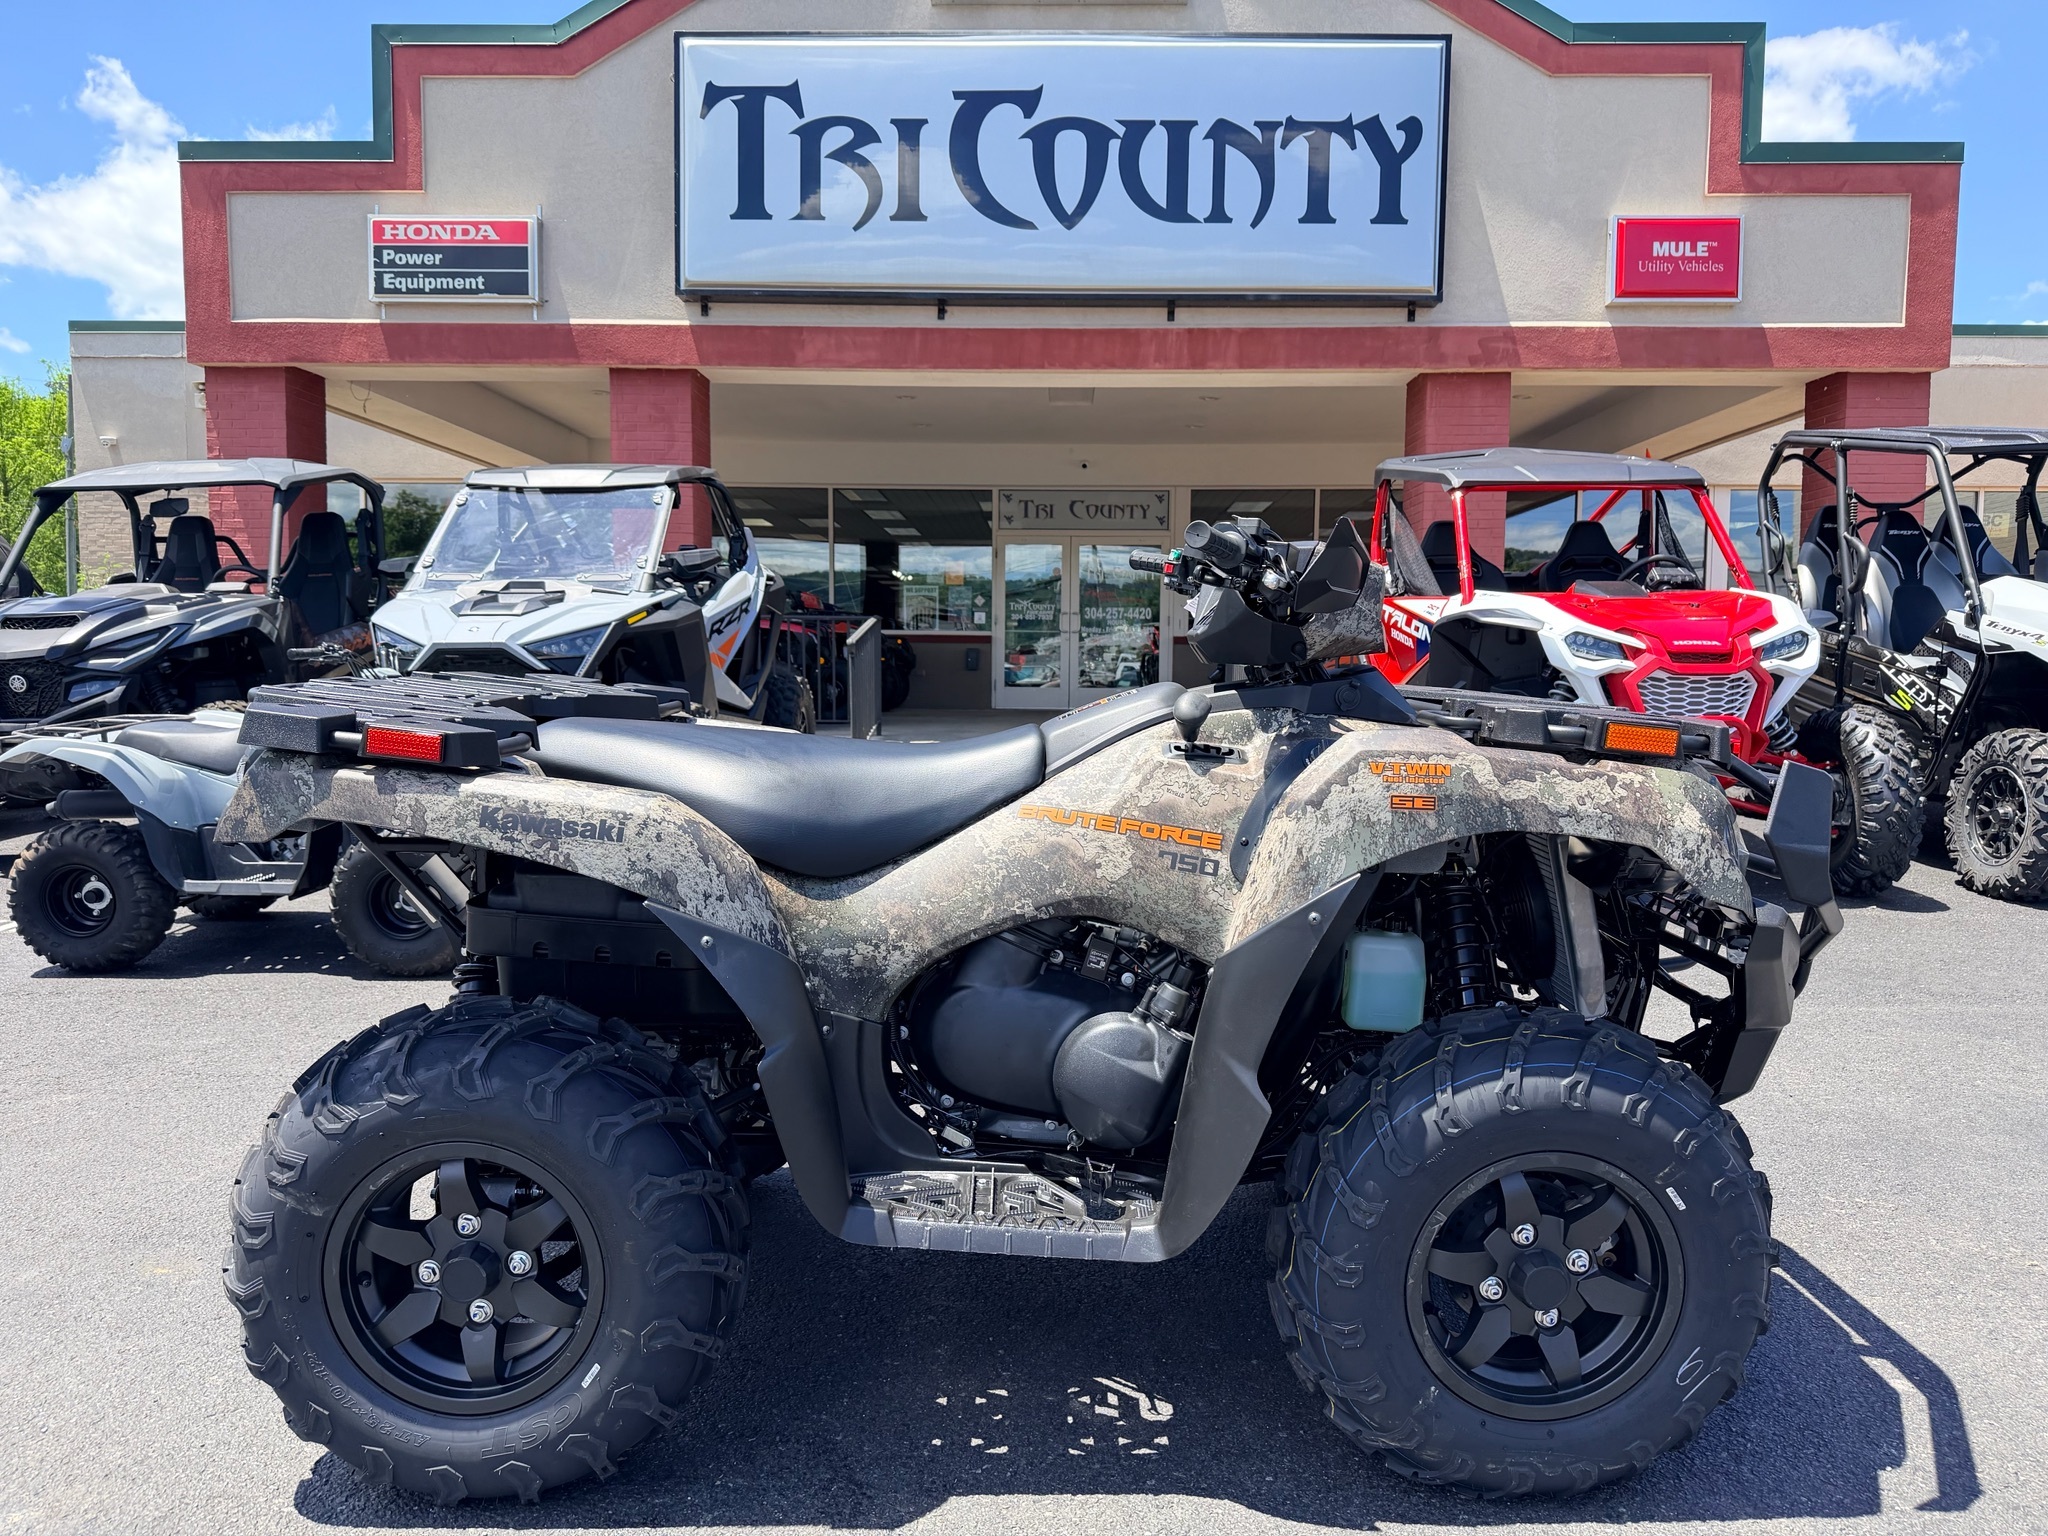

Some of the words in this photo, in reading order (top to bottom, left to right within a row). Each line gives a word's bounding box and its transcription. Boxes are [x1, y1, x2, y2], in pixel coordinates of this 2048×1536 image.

[700, 78, 929, 232] TRI
[948, 82, 1424, 231] COUNTY
[382, 224, 500, 240] HONDA
[382, 249, 443, 265] Power
[1638, 260, 1675, 274] Utility
[1678, 260, 1724, 273] Vehicles
[383, 273, 485, 292] Equipment
[1018, 499, 1056, 520] TRI
[1068, 499, 1151, 520] COUNTY
[708, 595, 752, 642] RZR
[1084, 607, 1152, 620] 304-257-4420
[1391, 628, 1415, 650] HONDA
[1368, 761, 1452, 777] V-TWIN
[1382, 774, 1404, 783] Fuel
[1405, 775, 1445, 784] Injected
[1391, 795, 1437, 810] SE
[479, 805, 626, 843] Kawasaki
[1017, 804, 1117, 832] BRUTE
[1118, 817, 1225, 851] FORCE
[1158, 850, 1221, 877] 750
[480, 1392, 583, 1459] CST
